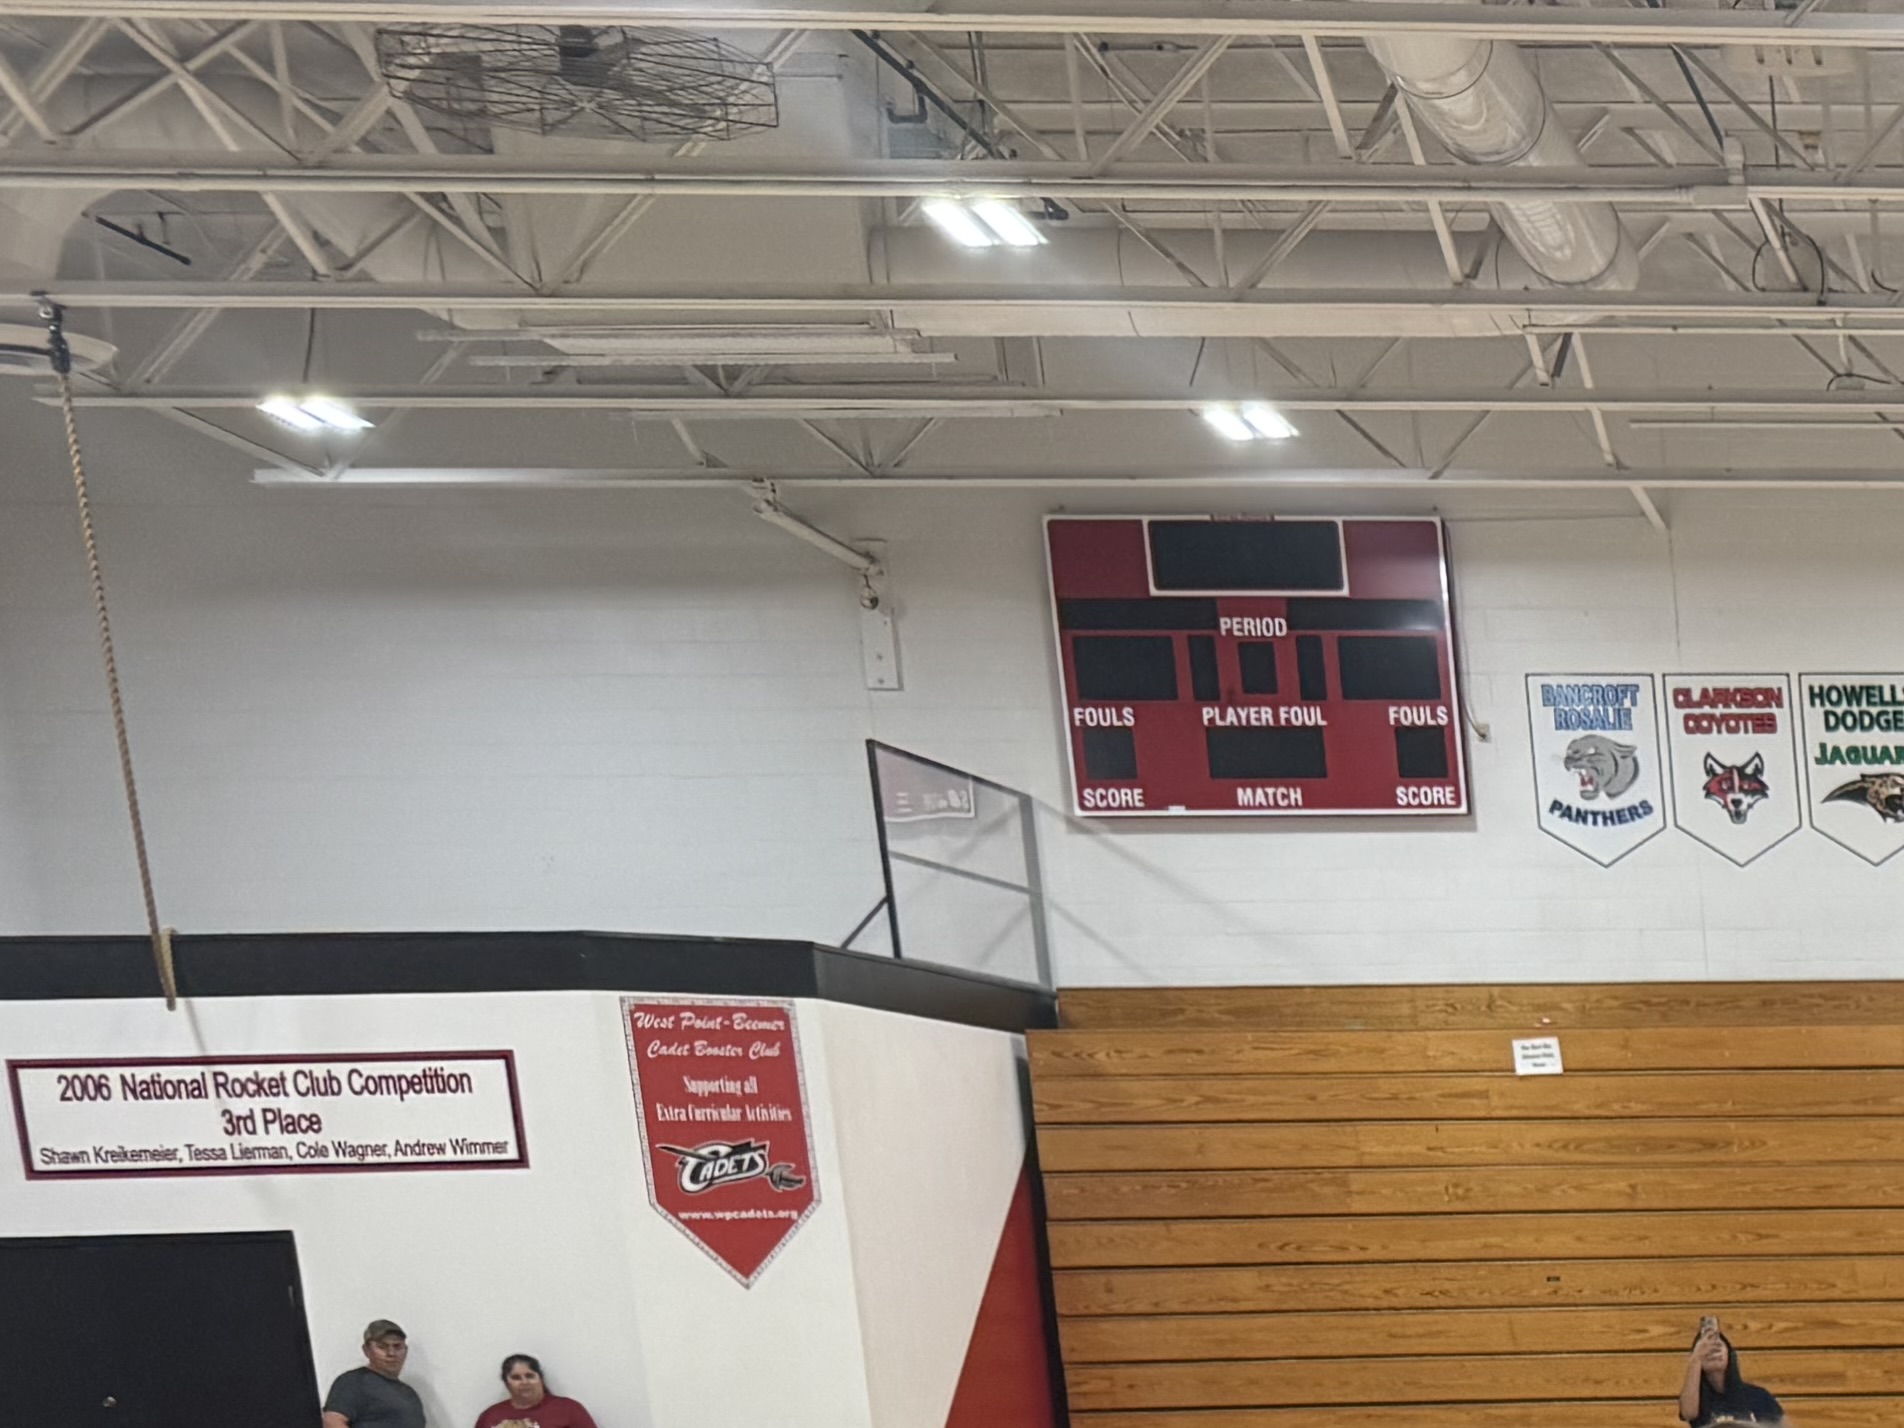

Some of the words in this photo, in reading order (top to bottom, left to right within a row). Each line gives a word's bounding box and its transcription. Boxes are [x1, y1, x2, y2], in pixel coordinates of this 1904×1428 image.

[1220, 617, 1287, 637] PERIOD
[1541, 684, 1639, 707] BANCROFT
[1673, 687, 1784, 709] CLARKSON
[1074, 707, 1134, 727] FOULS
[1202, 707, 1273, 727] PLAYER
[1280, 707, 1328, 727] FOUL
[1389, 706, 1448, 726] FOULS
[1554, 708, 1632, 731] ROSALIE
[1683, 713, 1777, 735] COYOTES
[1083, 788, 1145, 807] SCORE
[1237, 787, 1302, 807] MATCH
[1396, 787, 1456, 806] SCORE
[1548, 798, 1654, 827] PANTHERS
[634, 1012, 675, 1029] West
[647, 1040, 690, 1058] Cadet
[694, 1040, 743, 1057] Booster
[749, 1041, 781, 1060] Club
[57, 1074, 111, 1102] 2006
[120, 1072, 208, 1101] National
[213, 1070, 290, 1099] Rocket
[293, 1069, 342, 1097] Club
[348, 1067, 472, 1101] Competition
[683, 1076, 741, 1097] Supporting
[744, 1076, 758, 1094] all
[221, 1108, 256, 1136] 3rd
[262, 1107, 322, 1135] Place
[656, 1103, 686, 1122] Extra
[40, 1146, 90, 1165] Shawn
[184, 1144, 227, 1162] Tessa
[296, 1141, 329, 1159] Cole
[331, 1140, 391, 1162] Wagner,
[394, 1139, 447, 1157] Andrew
[449, 1137, 509, 1155] Wimmer
[681, 1144, 767, 1192] CADETS
[678, 1209, 798, 1221] www.wpcadets.org
